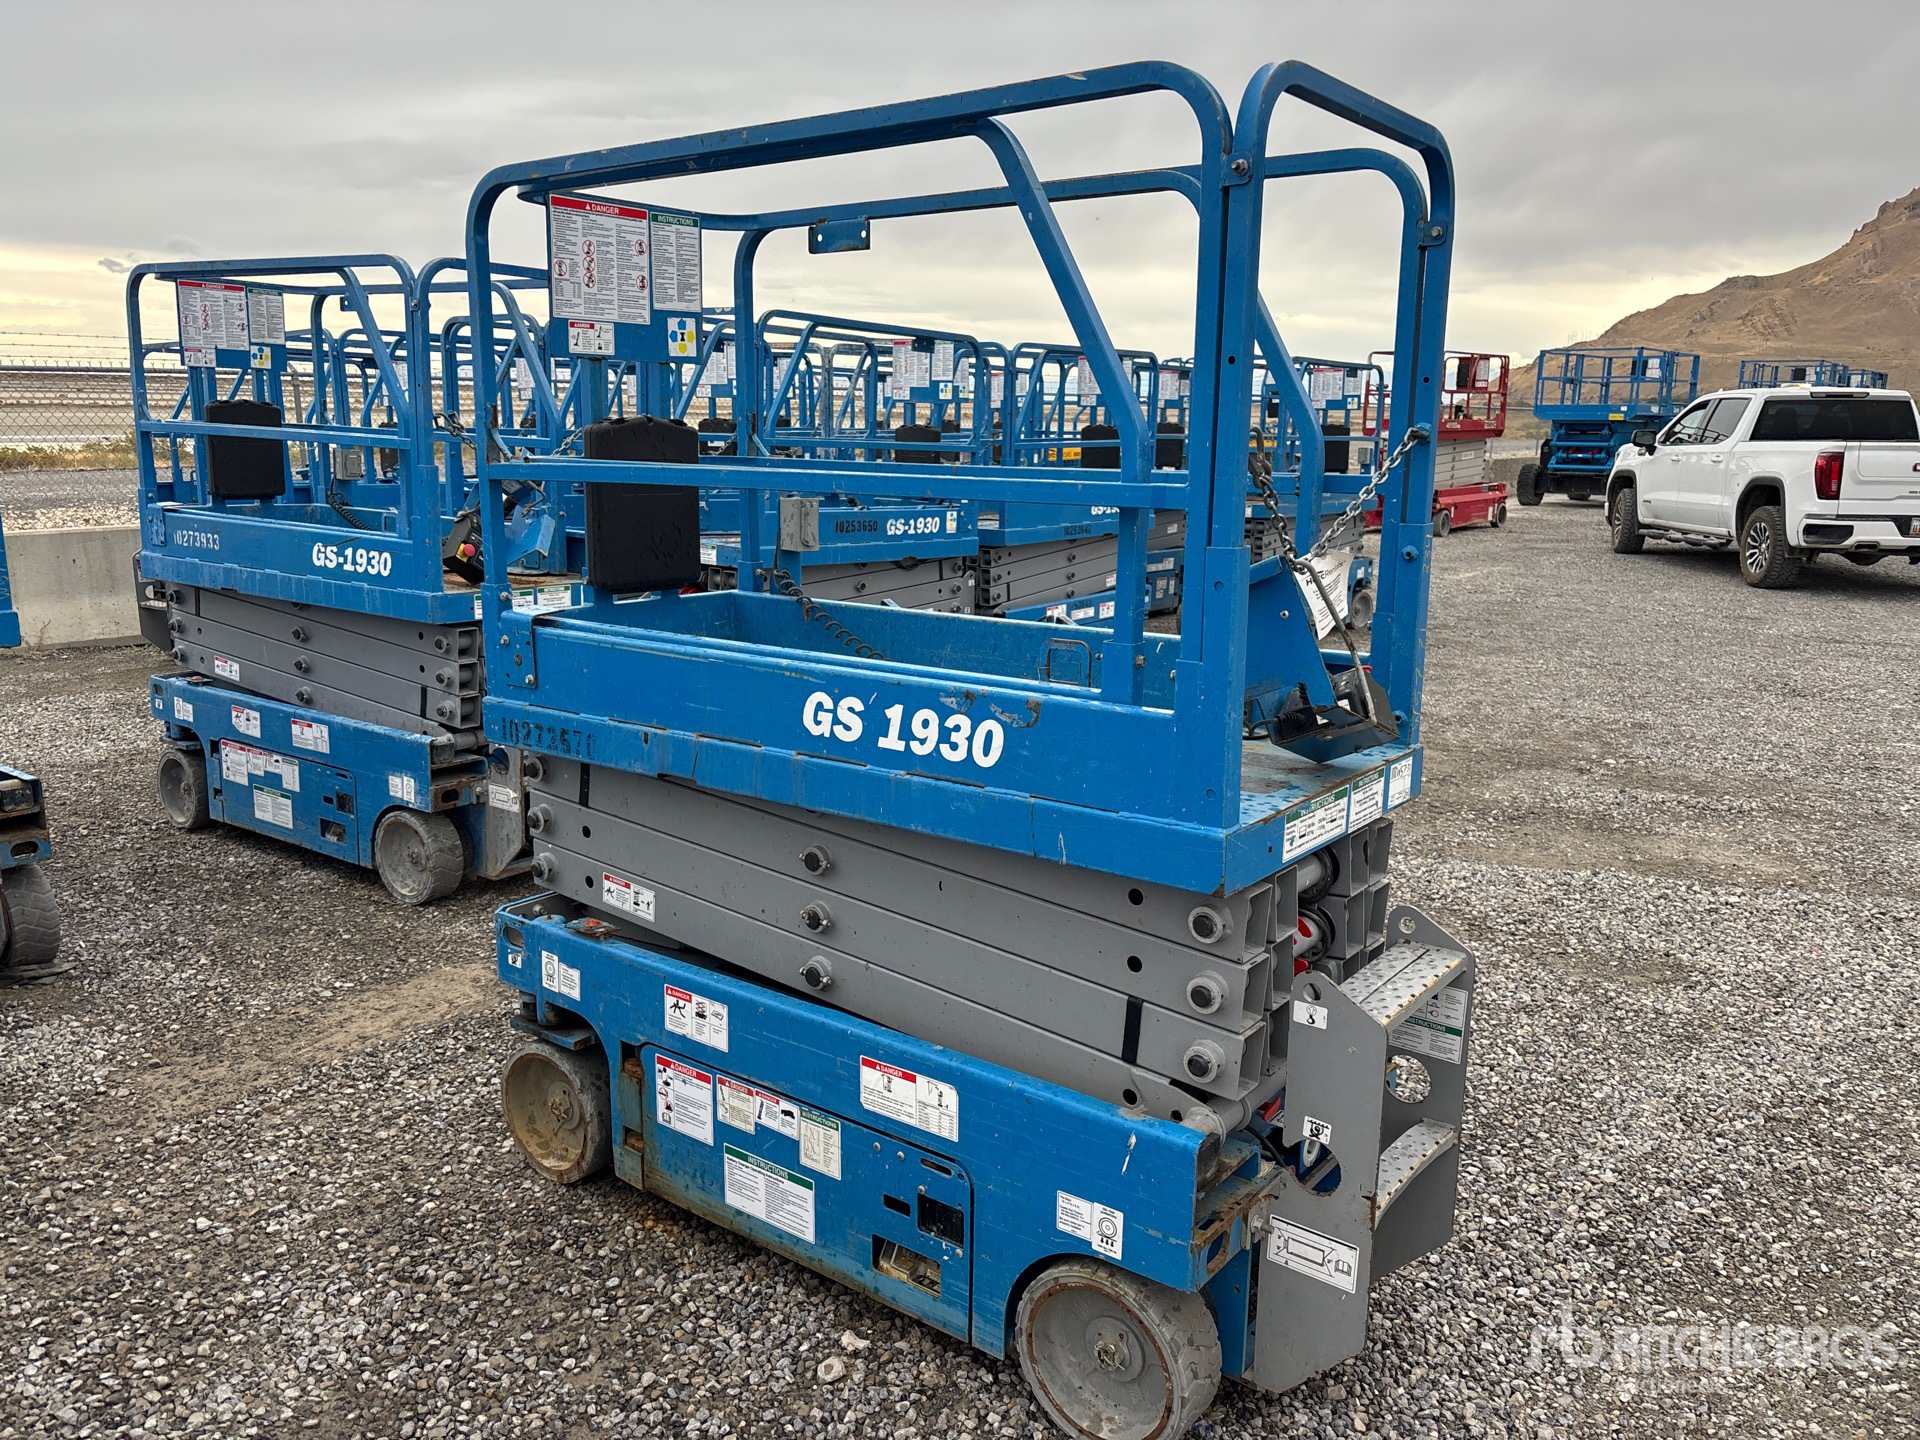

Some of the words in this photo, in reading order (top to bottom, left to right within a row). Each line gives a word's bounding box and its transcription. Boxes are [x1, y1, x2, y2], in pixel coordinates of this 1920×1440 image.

[591, 203, 619, 215] DANGER
[657, 215, 694, 226] INSTRUCTIONS
[886, 517, 940, 535] GS-1930
[173, 530, 220, 550] 10273933
[312, 543, 392, 577] GS-1930
[802, 691, 865, 742] GS
[877, 703, 1005, 768] 1930
[1407, 1016, 1446, 1032] NSTRUCTIONS
[674, 1063, 697, 1078] DANGER
[880, 1066, 903, 1078] DANGER
[747, 1155, 789, 1180] INSTRUCTIONS
